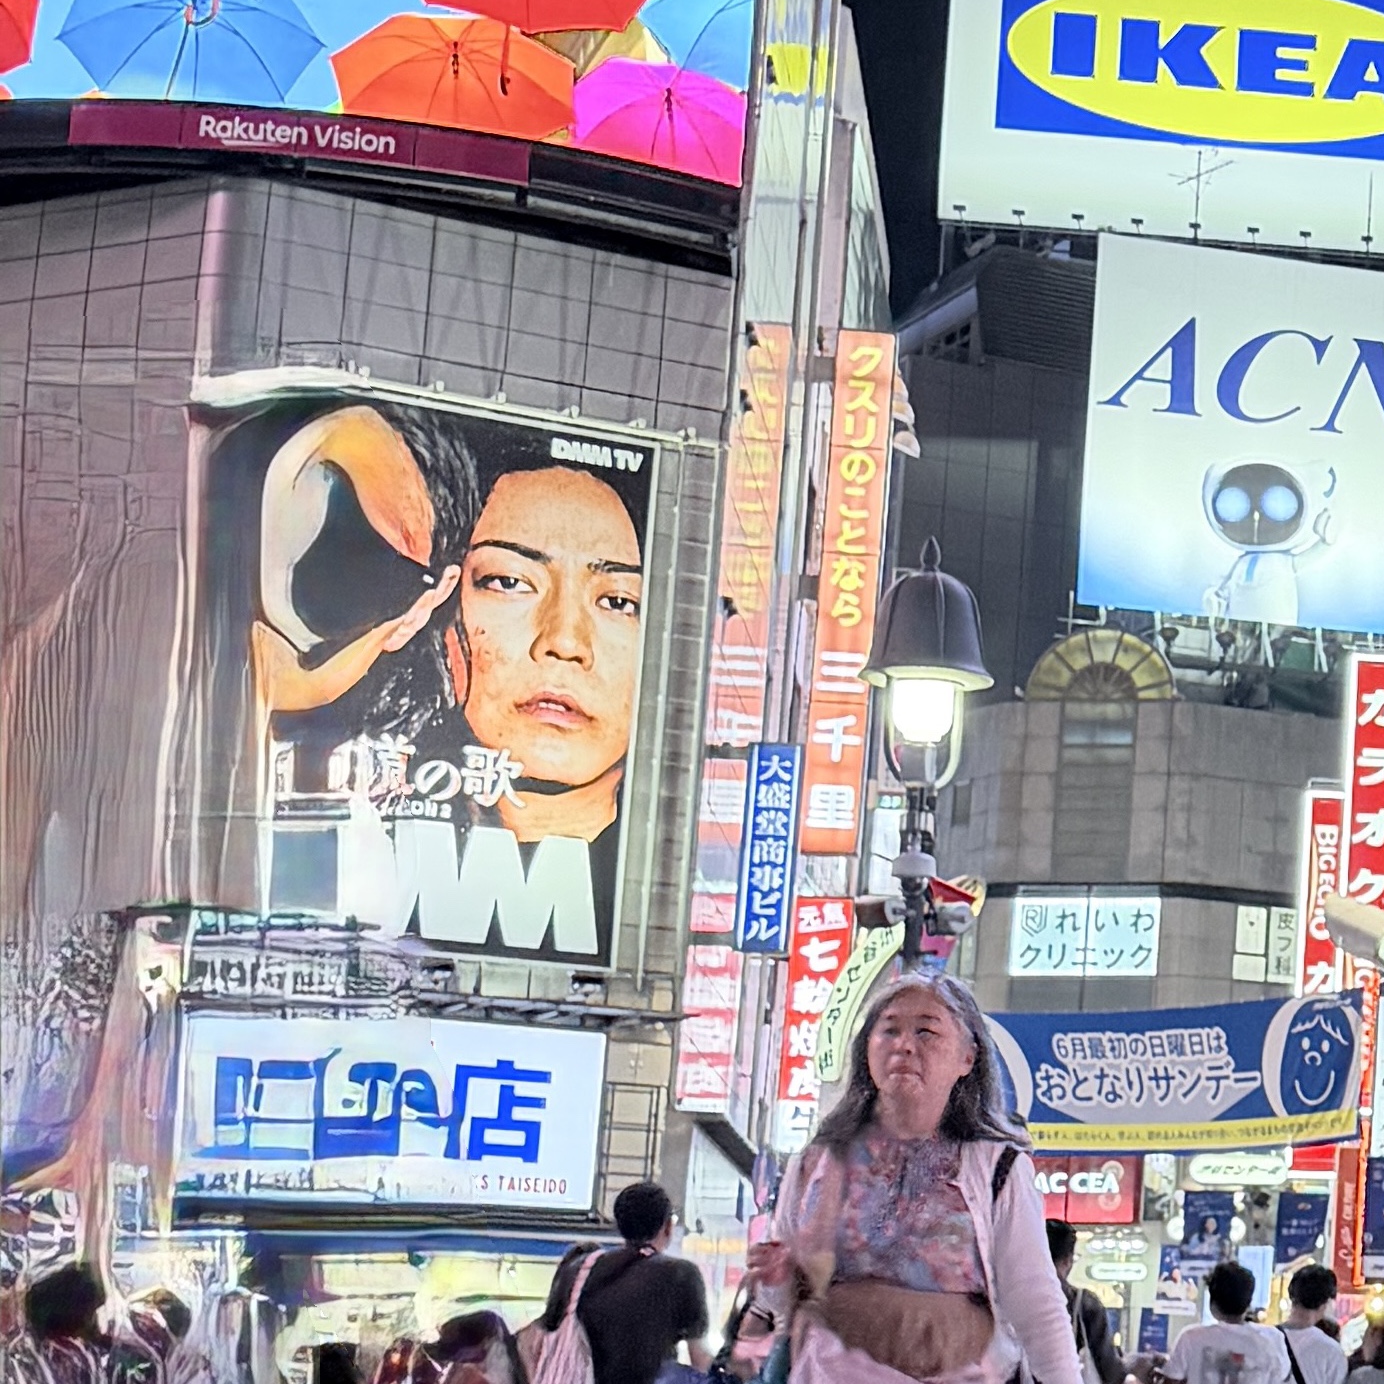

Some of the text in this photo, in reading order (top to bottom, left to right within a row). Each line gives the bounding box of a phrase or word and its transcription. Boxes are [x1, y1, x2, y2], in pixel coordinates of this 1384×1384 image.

[199, 114, 396, 155] Rakuten Vision
[550, 437, 643, 472] DMM TV
[831, 345, 884, 628] クスリのことなら
[806, 651, 868, 830] 三千里
[746, 754, 793, 943] 大盛堂商事ビル
[1055, 909, 1154, 934] れいわ
[1020, 944, 1152, 970] クリニック
[1056, 1029, 1225, 1060] 6月最初の日曜日は
[1040, 1062, 1259, 1103] おとなりサンデー
[498, 1176, 568, 1196] TAISEIDO
